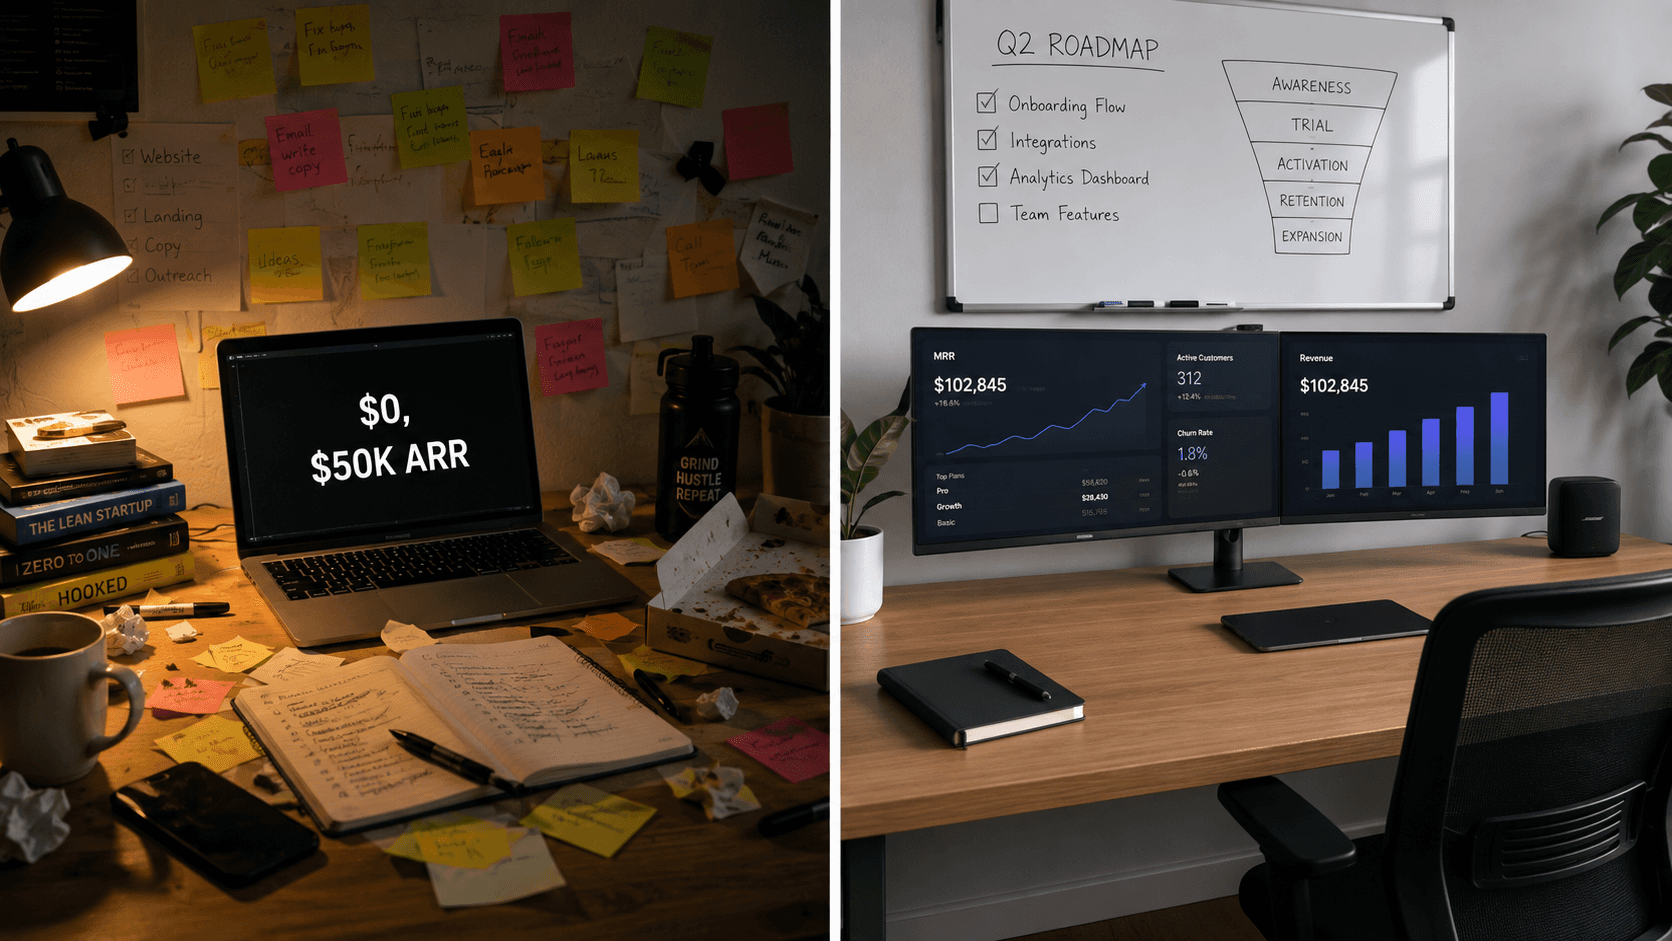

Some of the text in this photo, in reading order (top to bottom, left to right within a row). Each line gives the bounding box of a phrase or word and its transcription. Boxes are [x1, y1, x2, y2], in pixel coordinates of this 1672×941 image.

[998, 29, 1158, 60] Q2 ROADMAP
[1272, 77, 1351, 94] AWARENESS
[1009, 95, 1125, 120] Onboarding Flow
[1292, 118, 1333, 132] TRIAL
[1010, 132, 1097, 155] Integrations
[140, 147, 202, 164] Website
[281, 144, 317, 161] write
[288, 160, 321, 179] copy
[1278, 157, 1347, 171] ACTIVATION
[1010, 168, 1149, 191] Analytics Dashboard
[1280, 194, 1344, 207] RETENTION
[144, 207, 203, 230] Landing
[1010, 205, 1119, 221] Team Features
[1283, 230, 1342, 242] EXPANSION
[145, 236, 181, 259] Copy
[145, 267, 212, 283] Outreach
[934, 352, 955, 360] MRR
[935, 376, 1006, 394] $102,845
[1178, 371, 1201, 385] 312
[1301, 377, 1368, 394] $102,845
[360, 392, 409, 430] $0,
[1178, 447, 1207, 460] 1.8%
[311, 439, 470, 486] $50K ARR
[680, 456, 719, 471] GRIND
[676, 470, 722, 487] HUSTLE
[676, 486, 721, 502] REPEAT
[29, 499, 153, 536] THE LEAN STARTUP
[22, 555, 65, 576] ZERO
[66, 552, 85, 565] TO
[86, 544, 121, 562] ONE
[58, 576, 128, 606] HOOKED
